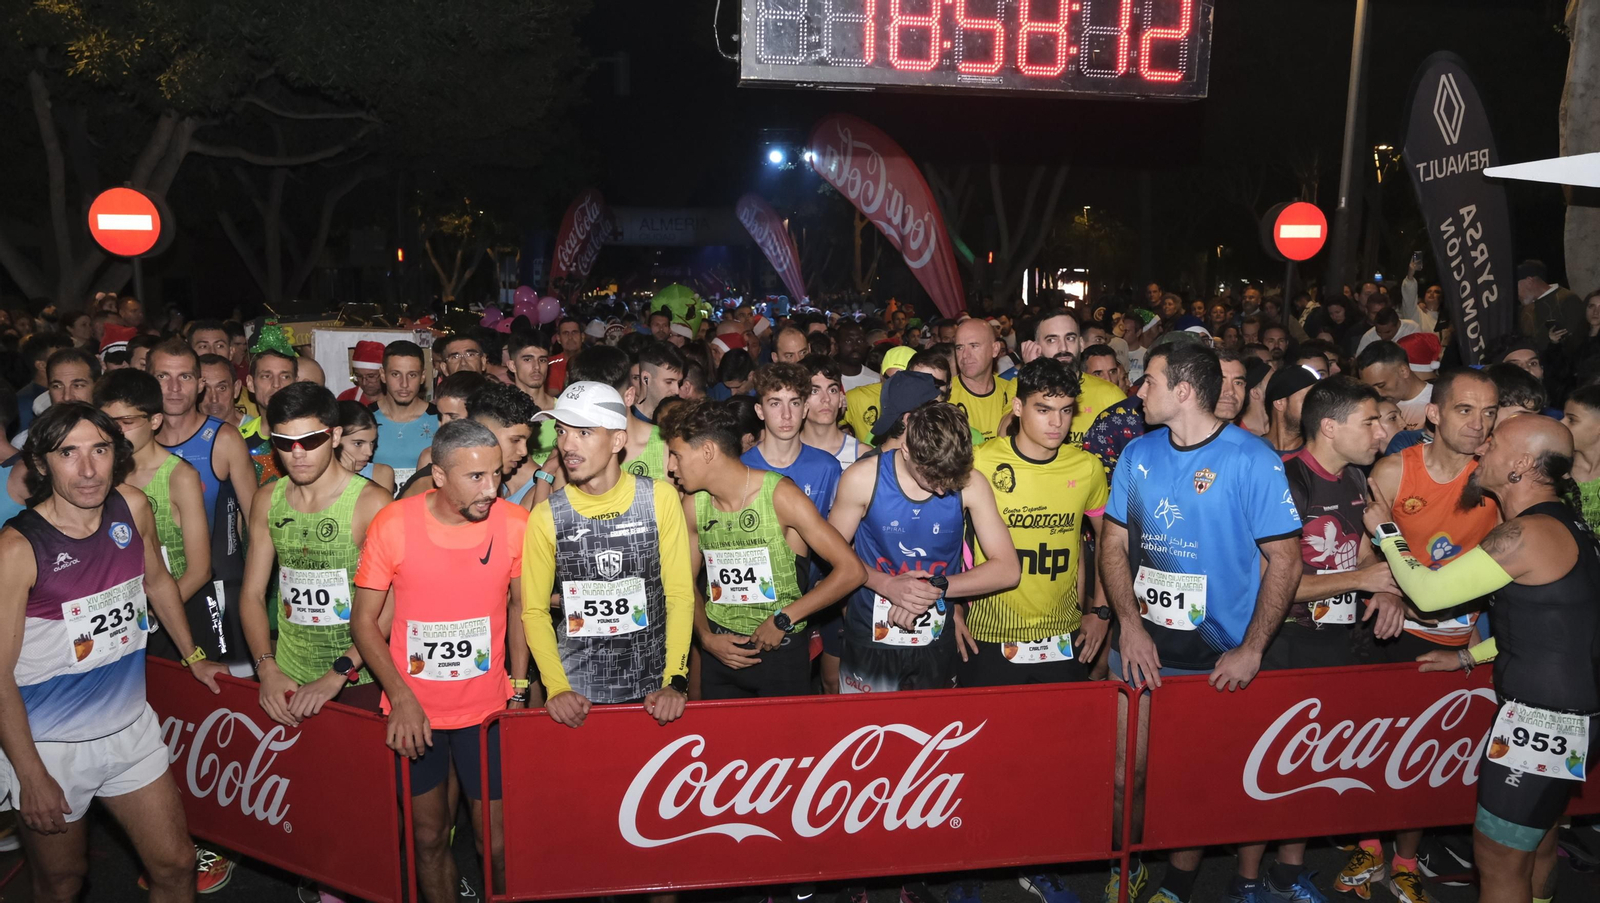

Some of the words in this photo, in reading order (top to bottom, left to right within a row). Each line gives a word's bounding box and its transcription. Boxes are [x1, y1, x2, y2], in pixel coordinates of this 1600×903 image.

[1003, 506, 1021, 515] Centro
[1007, 512, 1075, 529] SPORTGYM
[1140, 542, 1167, 553] rabian
[719, 567, 757, 584] 634
[113, 595, 121, 604] DE
[290, 587, 330, 606] 210
[1146, 588, 1184, 609] 961
[1332, 592, 1357, 605] 96
[584, 598, 629, 617] 538
[90, 602, 135, 636] 233
[423, 640, 472, 660] 739
[845, 676, 871, 693] GALO
[1544, 721, 1556, 730] DE
[1512, 727, 1567, 755] 953
[160, 708, 302, 826] a-Cola
[618, 718, 988, 848] Coca-Cola
